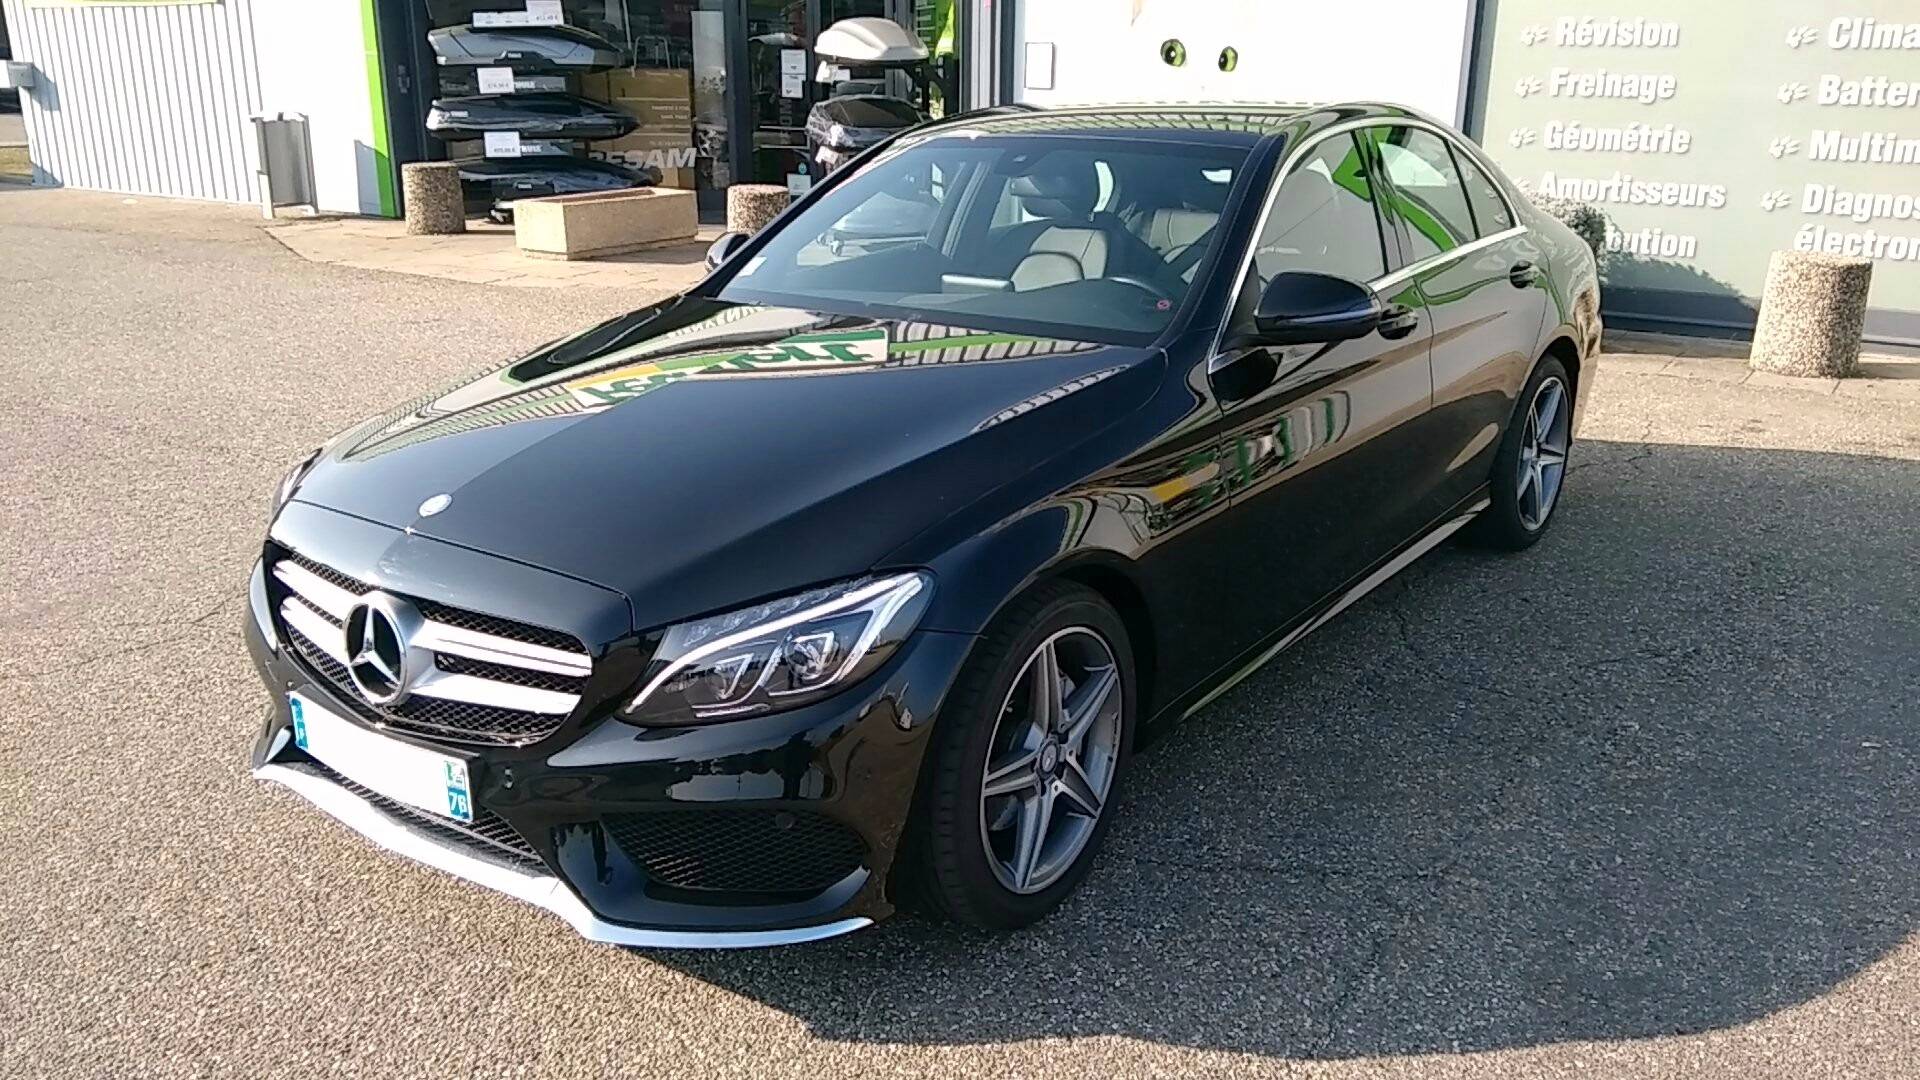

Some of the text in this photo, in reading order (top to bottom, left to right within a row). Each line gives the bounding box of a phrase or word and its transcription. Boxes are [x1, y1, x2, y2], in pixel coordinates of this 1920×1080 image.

[1555, 16, 1680, 48] Révision
[1827, 17, 1920, 50] Clima
[1548, 67, 1678, 104] Freinage
[1817, 74, 1920, 107] Batter
[1543, 120, 1692, 155] Géométrie
[1536, 170, 1727, 209] Amortisseurs
